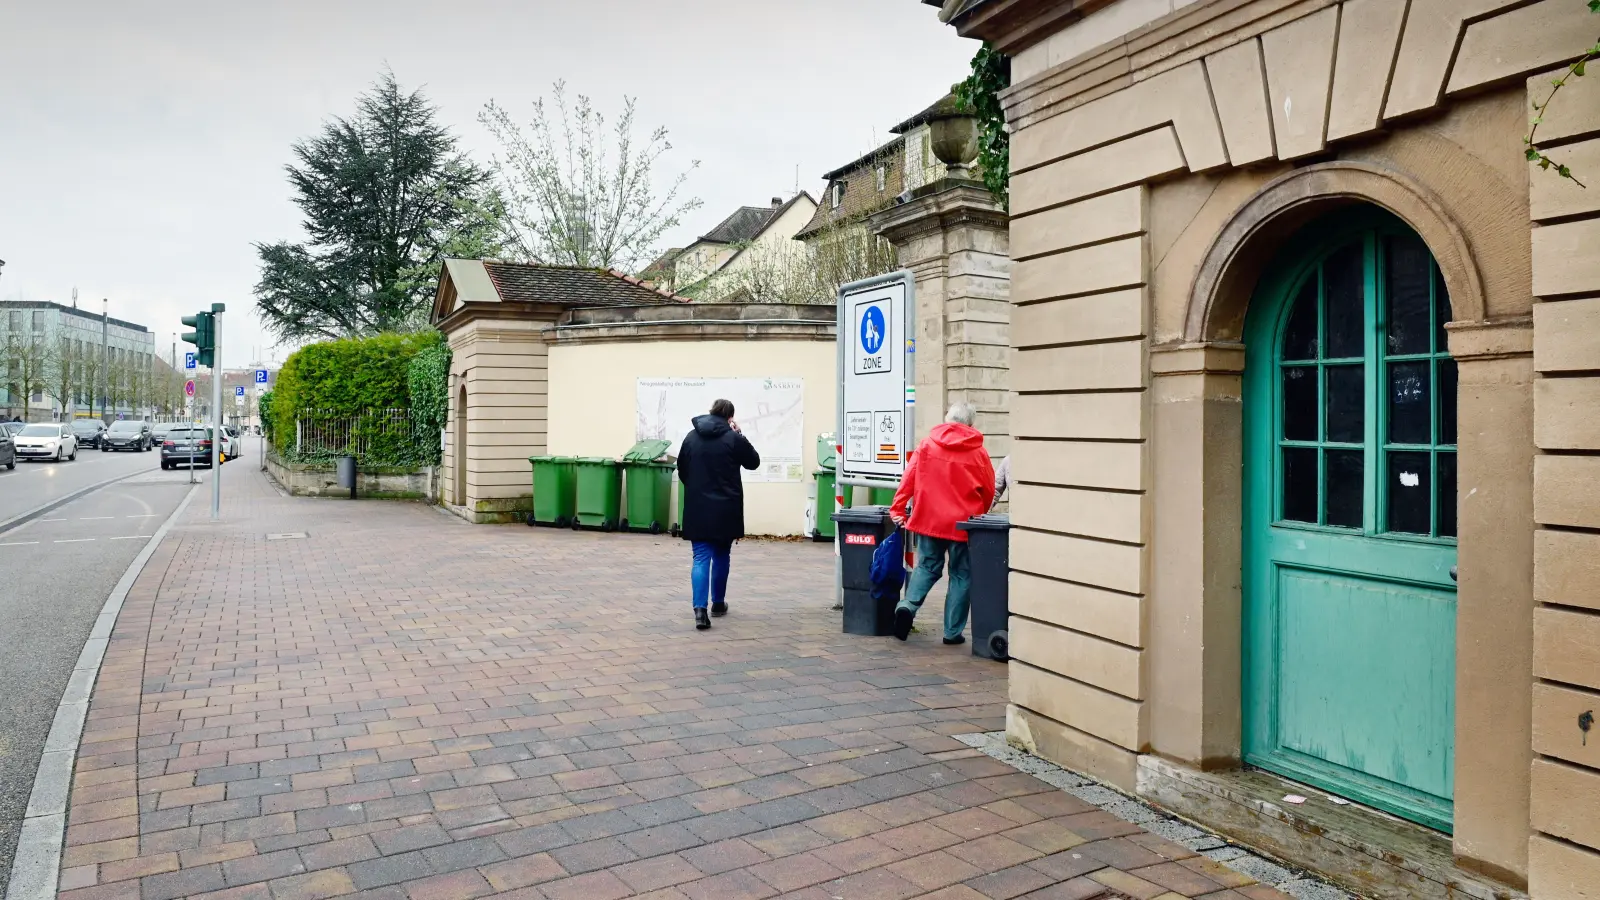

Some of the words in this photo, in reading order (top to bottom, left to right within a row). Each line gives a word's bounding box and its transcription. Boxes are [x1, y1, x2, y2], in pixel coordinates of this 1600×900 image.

[187, 355, 193, 367] P
[863, 356, 882, 370] ZONE
[257, 372, 264, 382] P
[848, 535, 871, 544] SULO
